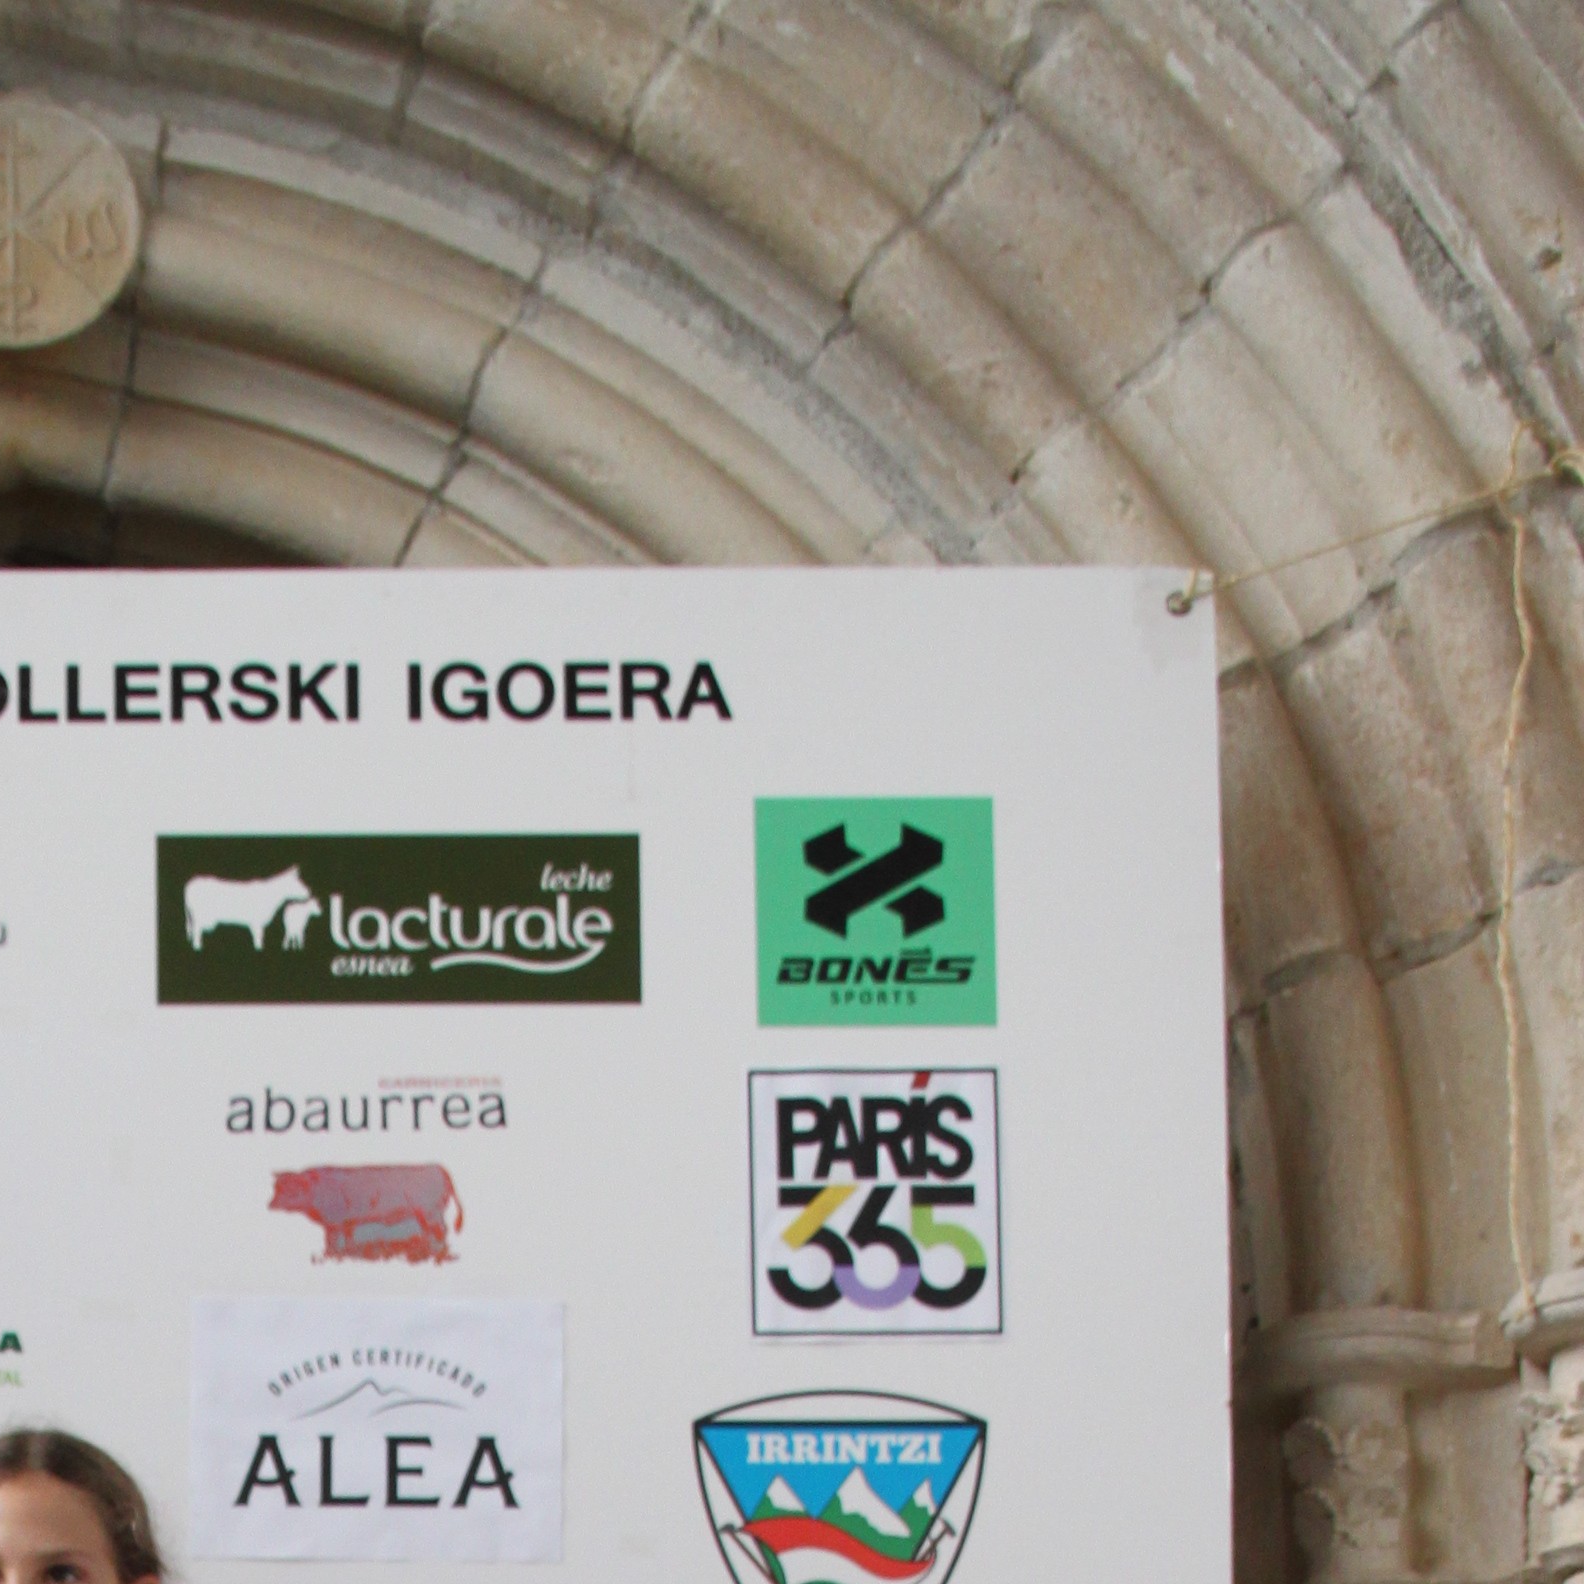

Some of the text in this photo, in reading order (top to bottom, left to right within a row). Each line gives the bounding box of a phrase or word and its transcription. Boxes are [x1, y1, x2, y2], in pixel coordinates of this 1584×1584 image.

[407, 662, 733, 721] IGOERA
[540, 862, 613, 891] leche
[329, 893, 613, 951] lacturale
[330, 954, 413, 976] esnea
[830, 990, 916, 1006] SPORTS
[226, 1086, 507, 1133] abaurrea
[767, 1184, 987, 1310] 365
[268, 1349, 486, 1397] ORIGEN CERTIFICADO
[234, 1434, 520, 1508] ALEA
[746, 1433, 942, 1465] IRRINTZI
